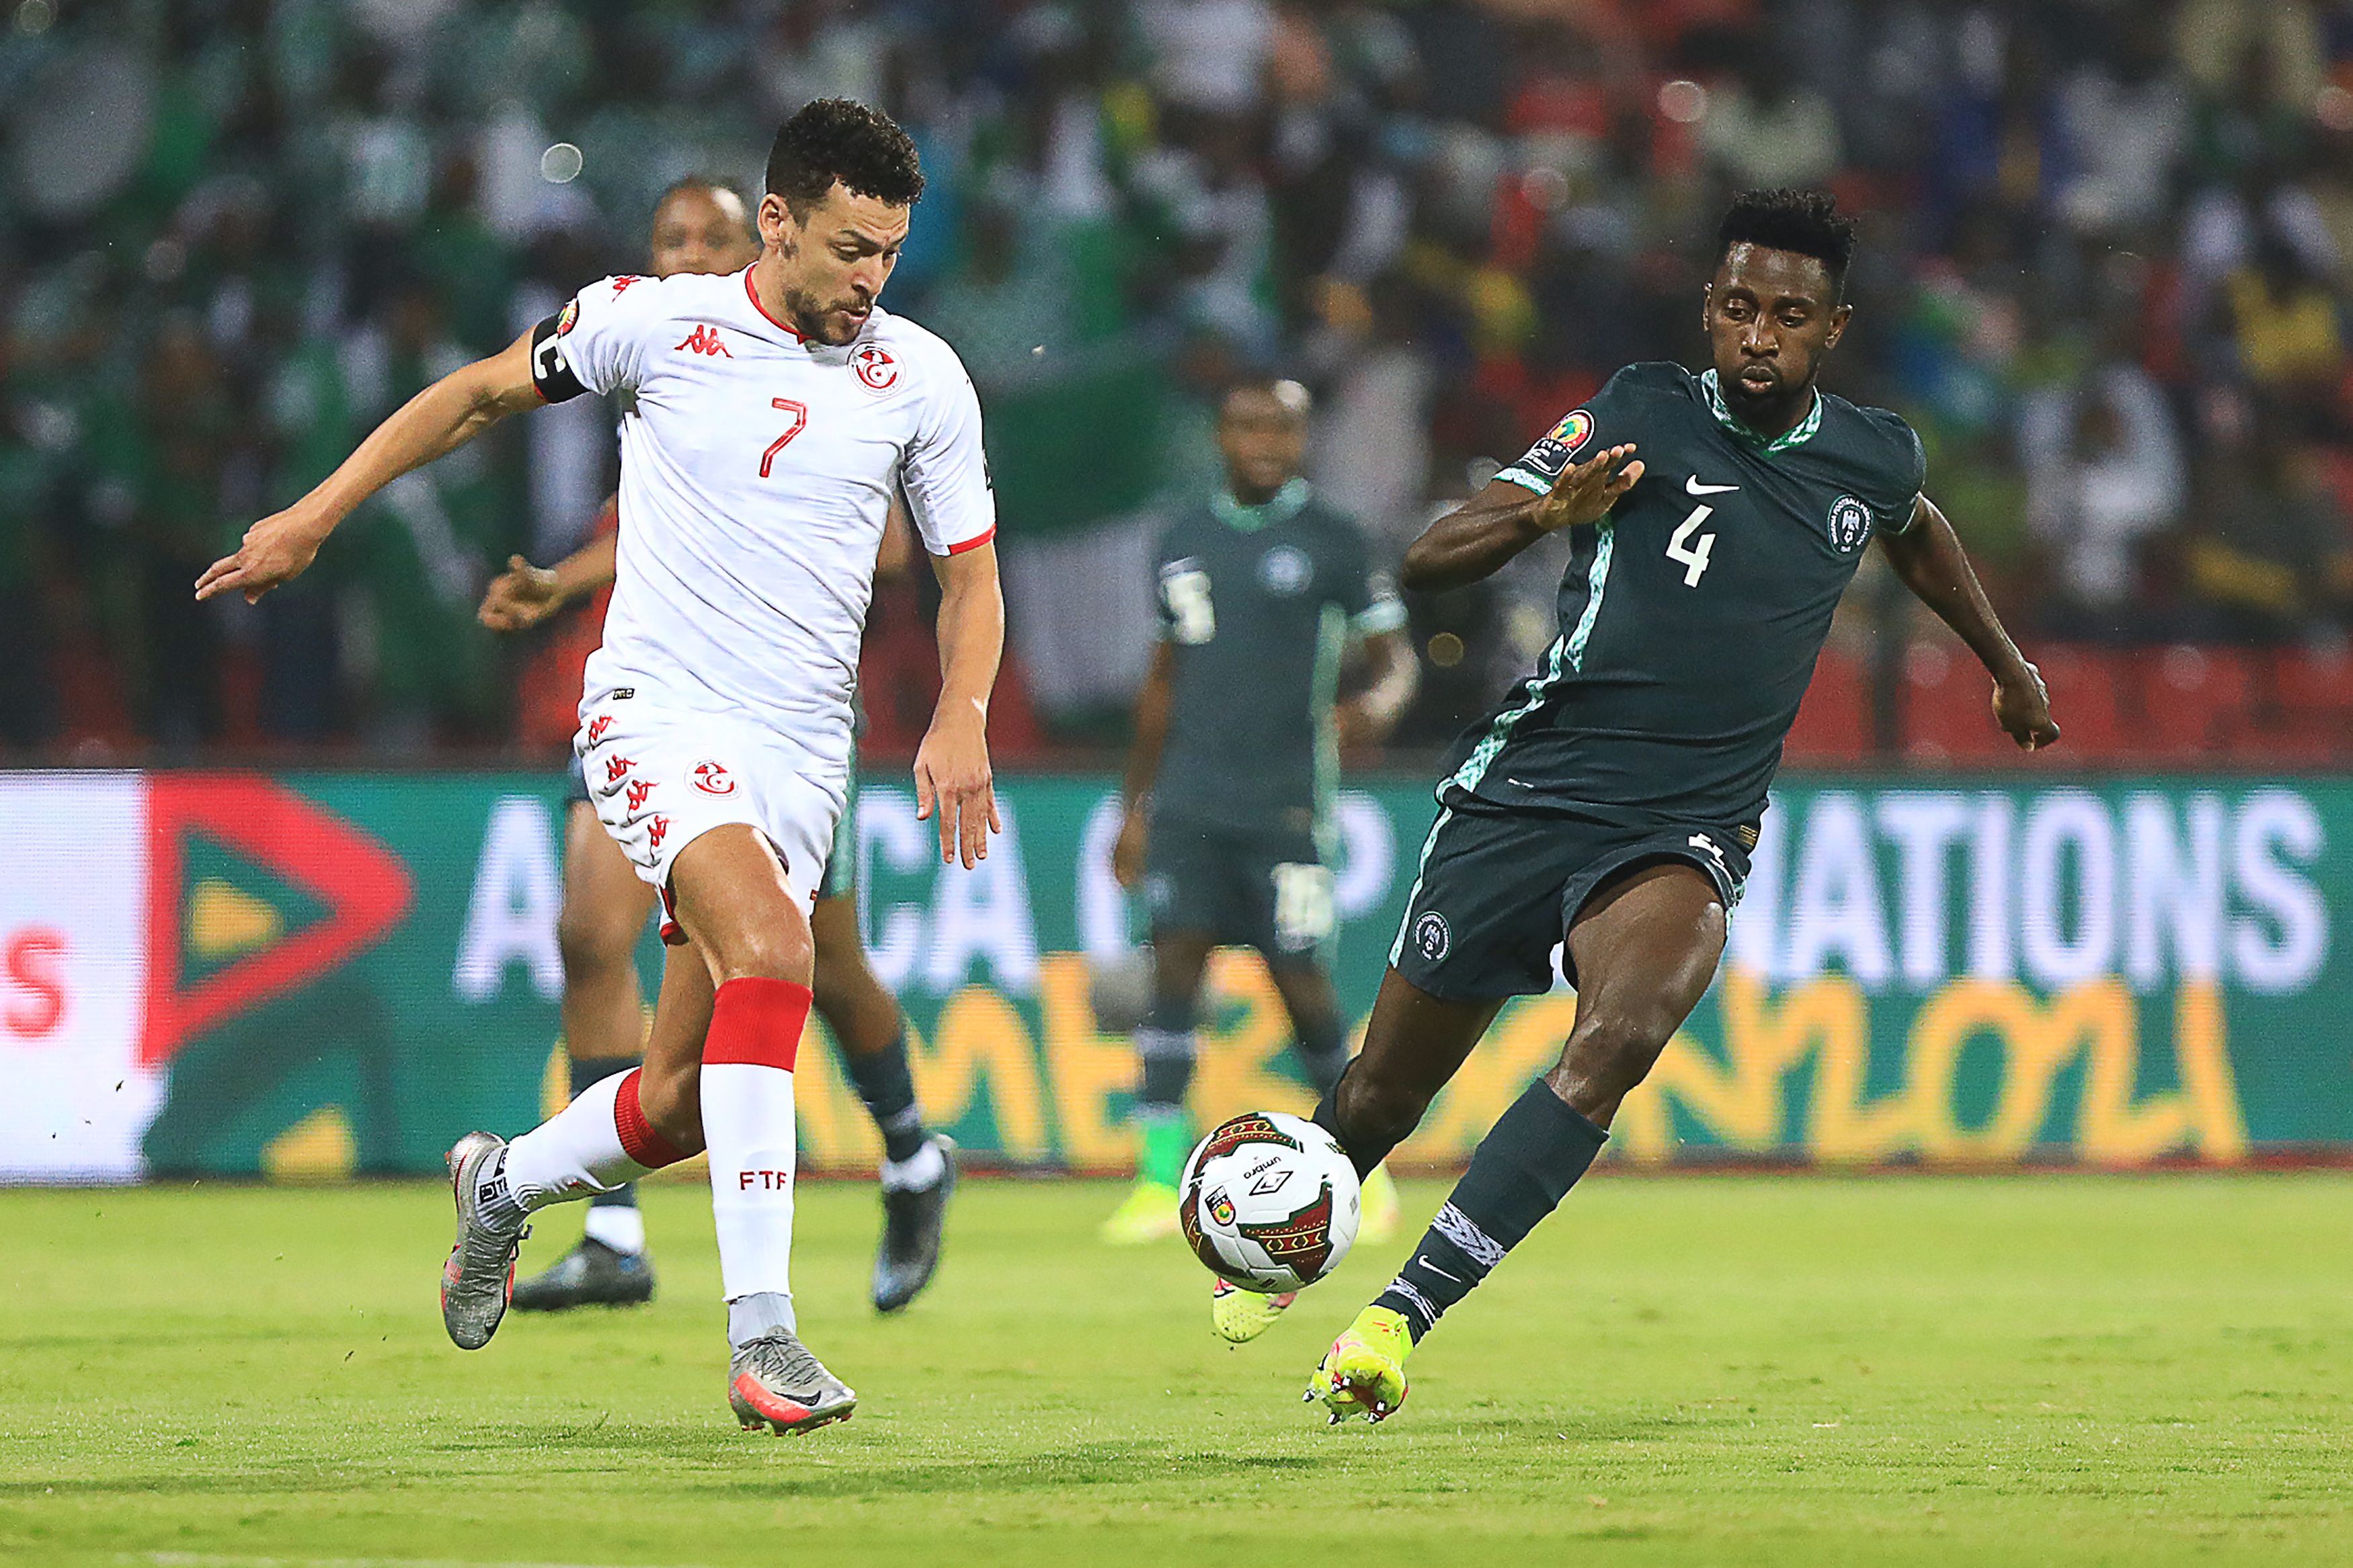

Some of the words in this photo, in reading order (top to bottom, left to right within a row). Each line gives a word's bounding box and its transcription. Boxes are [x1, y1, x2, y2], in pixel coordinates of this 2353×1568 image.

[759, 398, 807, 477] 7
[1666, 504, 1716, 588] 4
[740, 1170, 787, 1190] FTF
[1244, 1156, 1281, 1179] umbro
